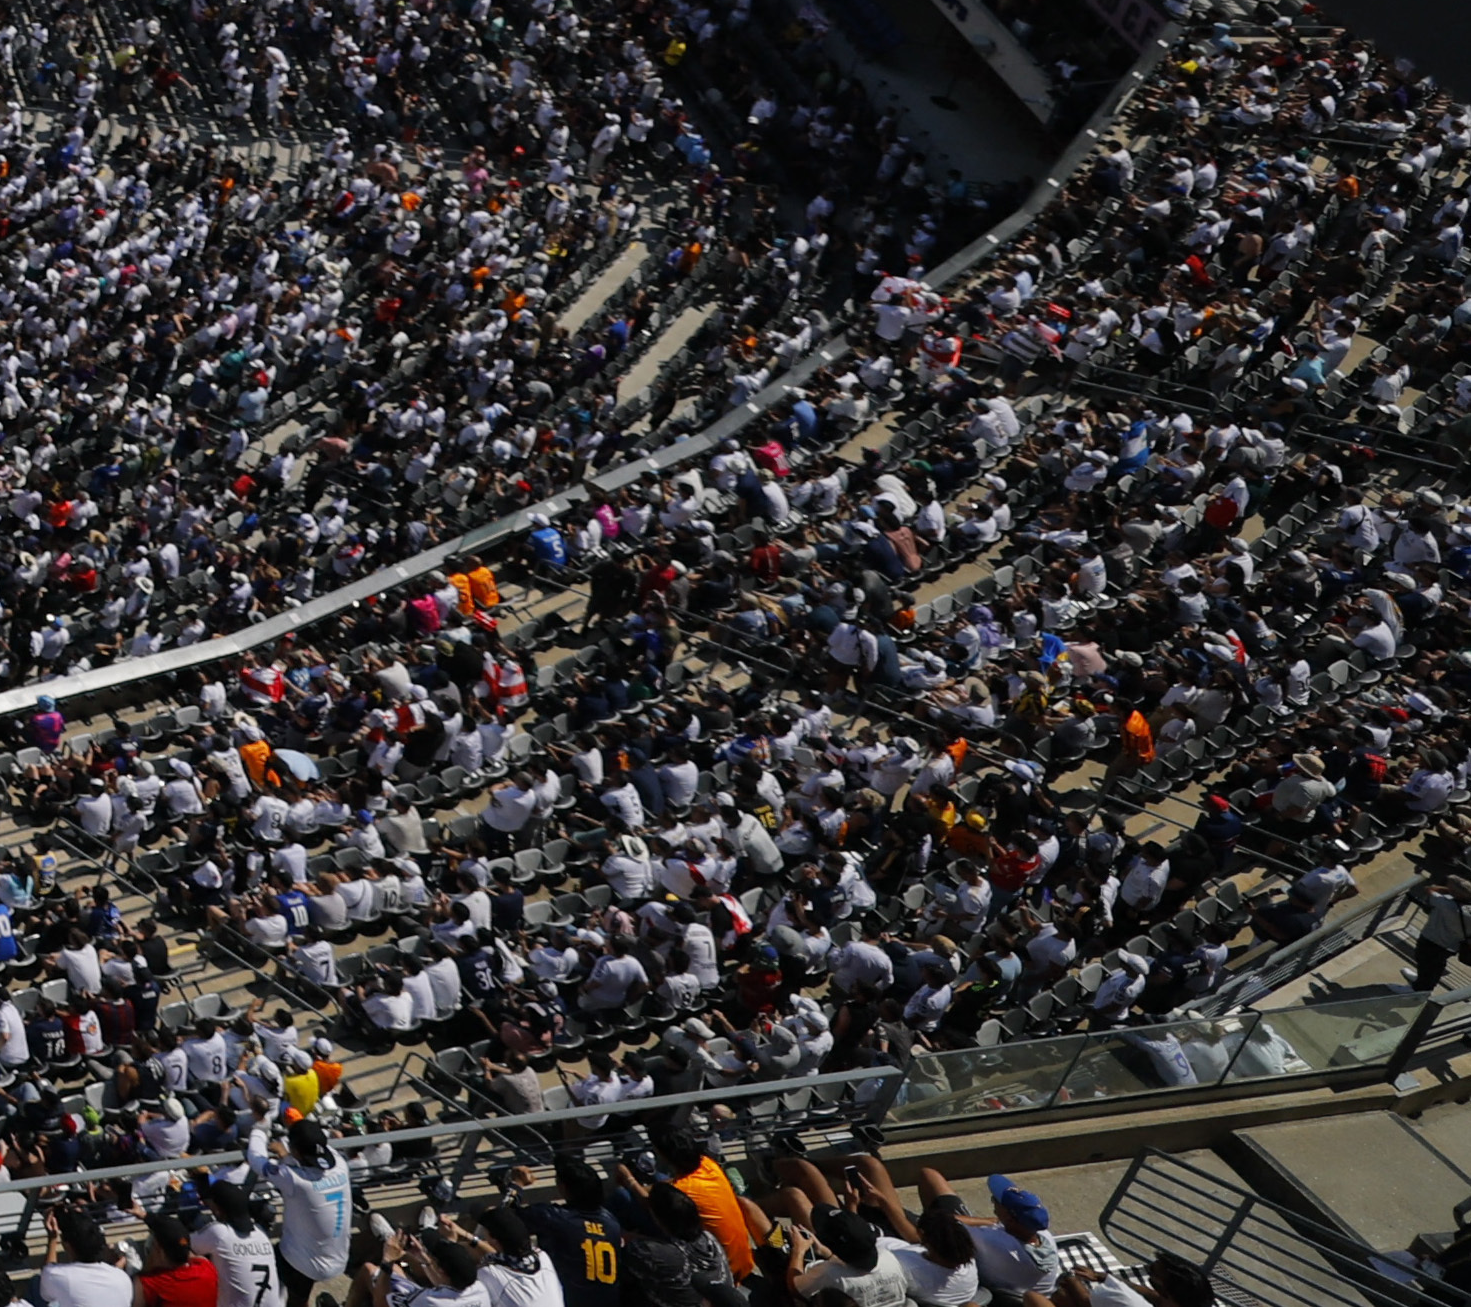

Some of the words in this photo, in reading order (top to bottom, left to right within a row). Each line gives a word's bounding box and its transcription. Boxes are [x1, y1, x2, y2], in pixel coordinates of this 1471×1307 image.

[211, 1056, 222, 1075] 8
[324, 1191, 344, 1238] 7
[581, 1239, 616, 1285] 10
